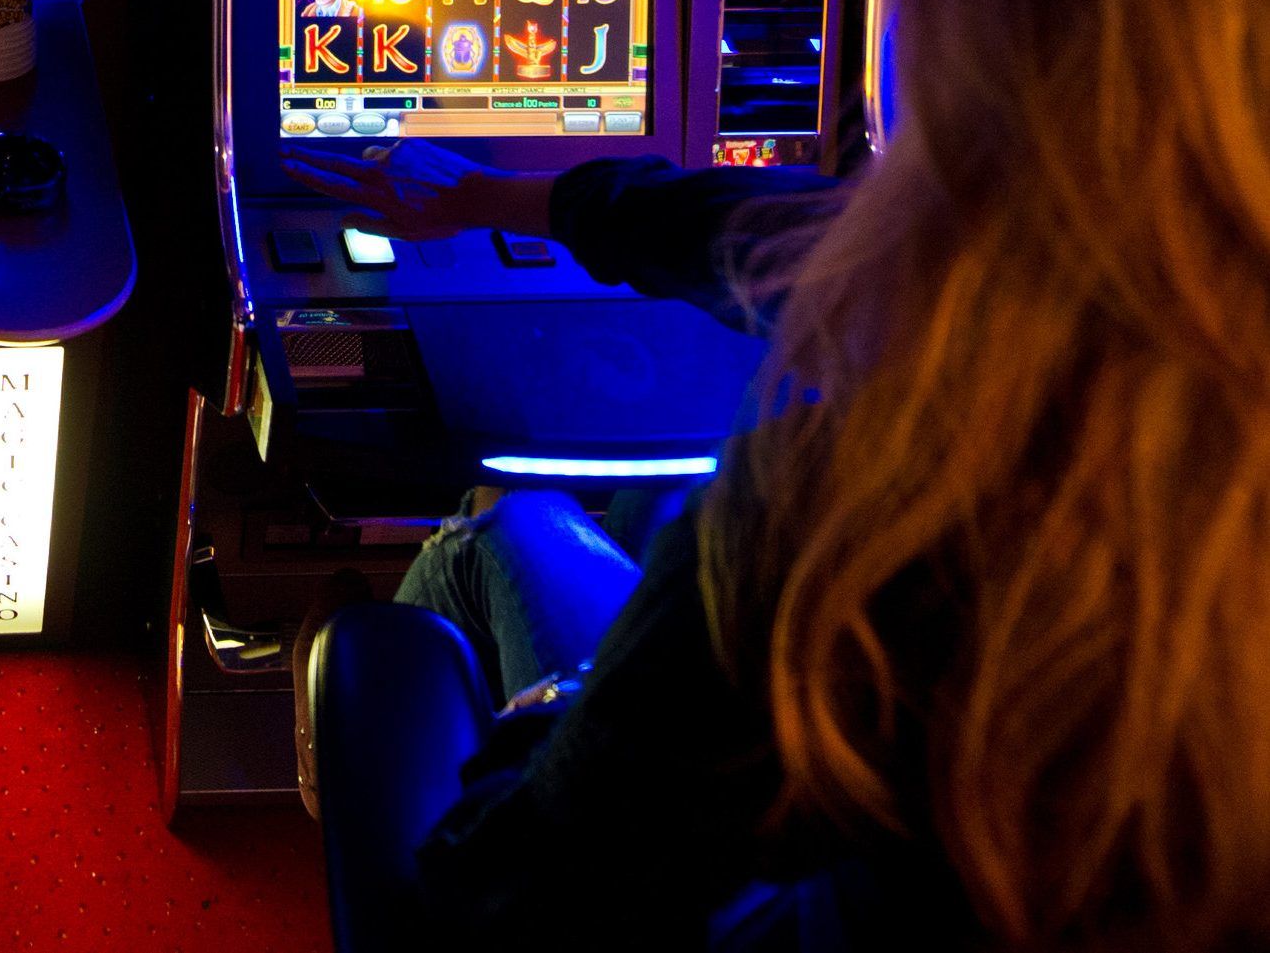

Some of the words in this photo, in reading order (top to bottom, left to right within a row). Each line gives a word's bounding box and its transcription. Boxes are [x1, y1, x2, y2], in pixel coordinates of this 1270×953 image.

[304, 24, 350, 74] K
[372, 24, 418, 73] K
[580, 23, 610, 75] J
